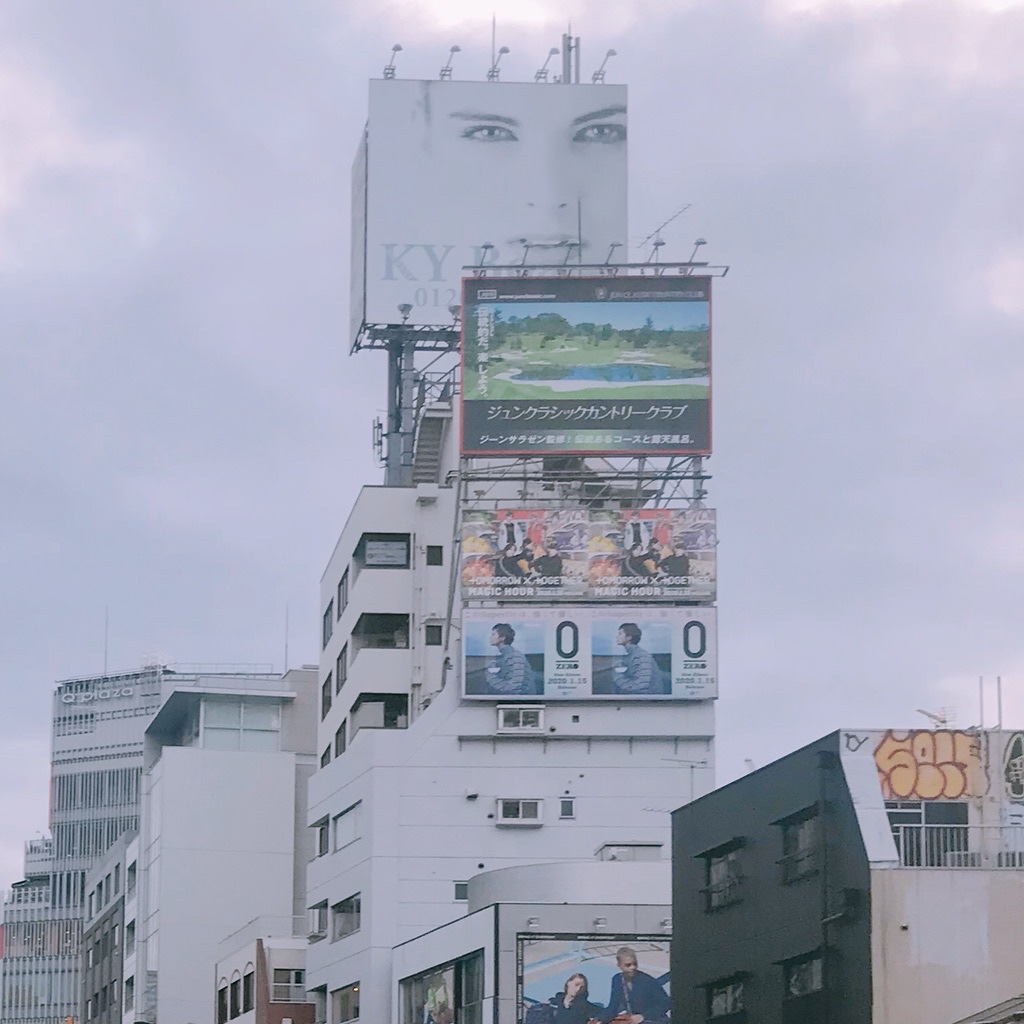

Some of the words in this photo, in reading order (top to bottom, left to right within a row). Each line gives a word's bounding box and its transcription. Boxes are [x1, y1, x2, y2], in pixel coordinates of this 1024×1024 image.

[487, 405, 689, 421] ジュンクラシックカントリークラブ
